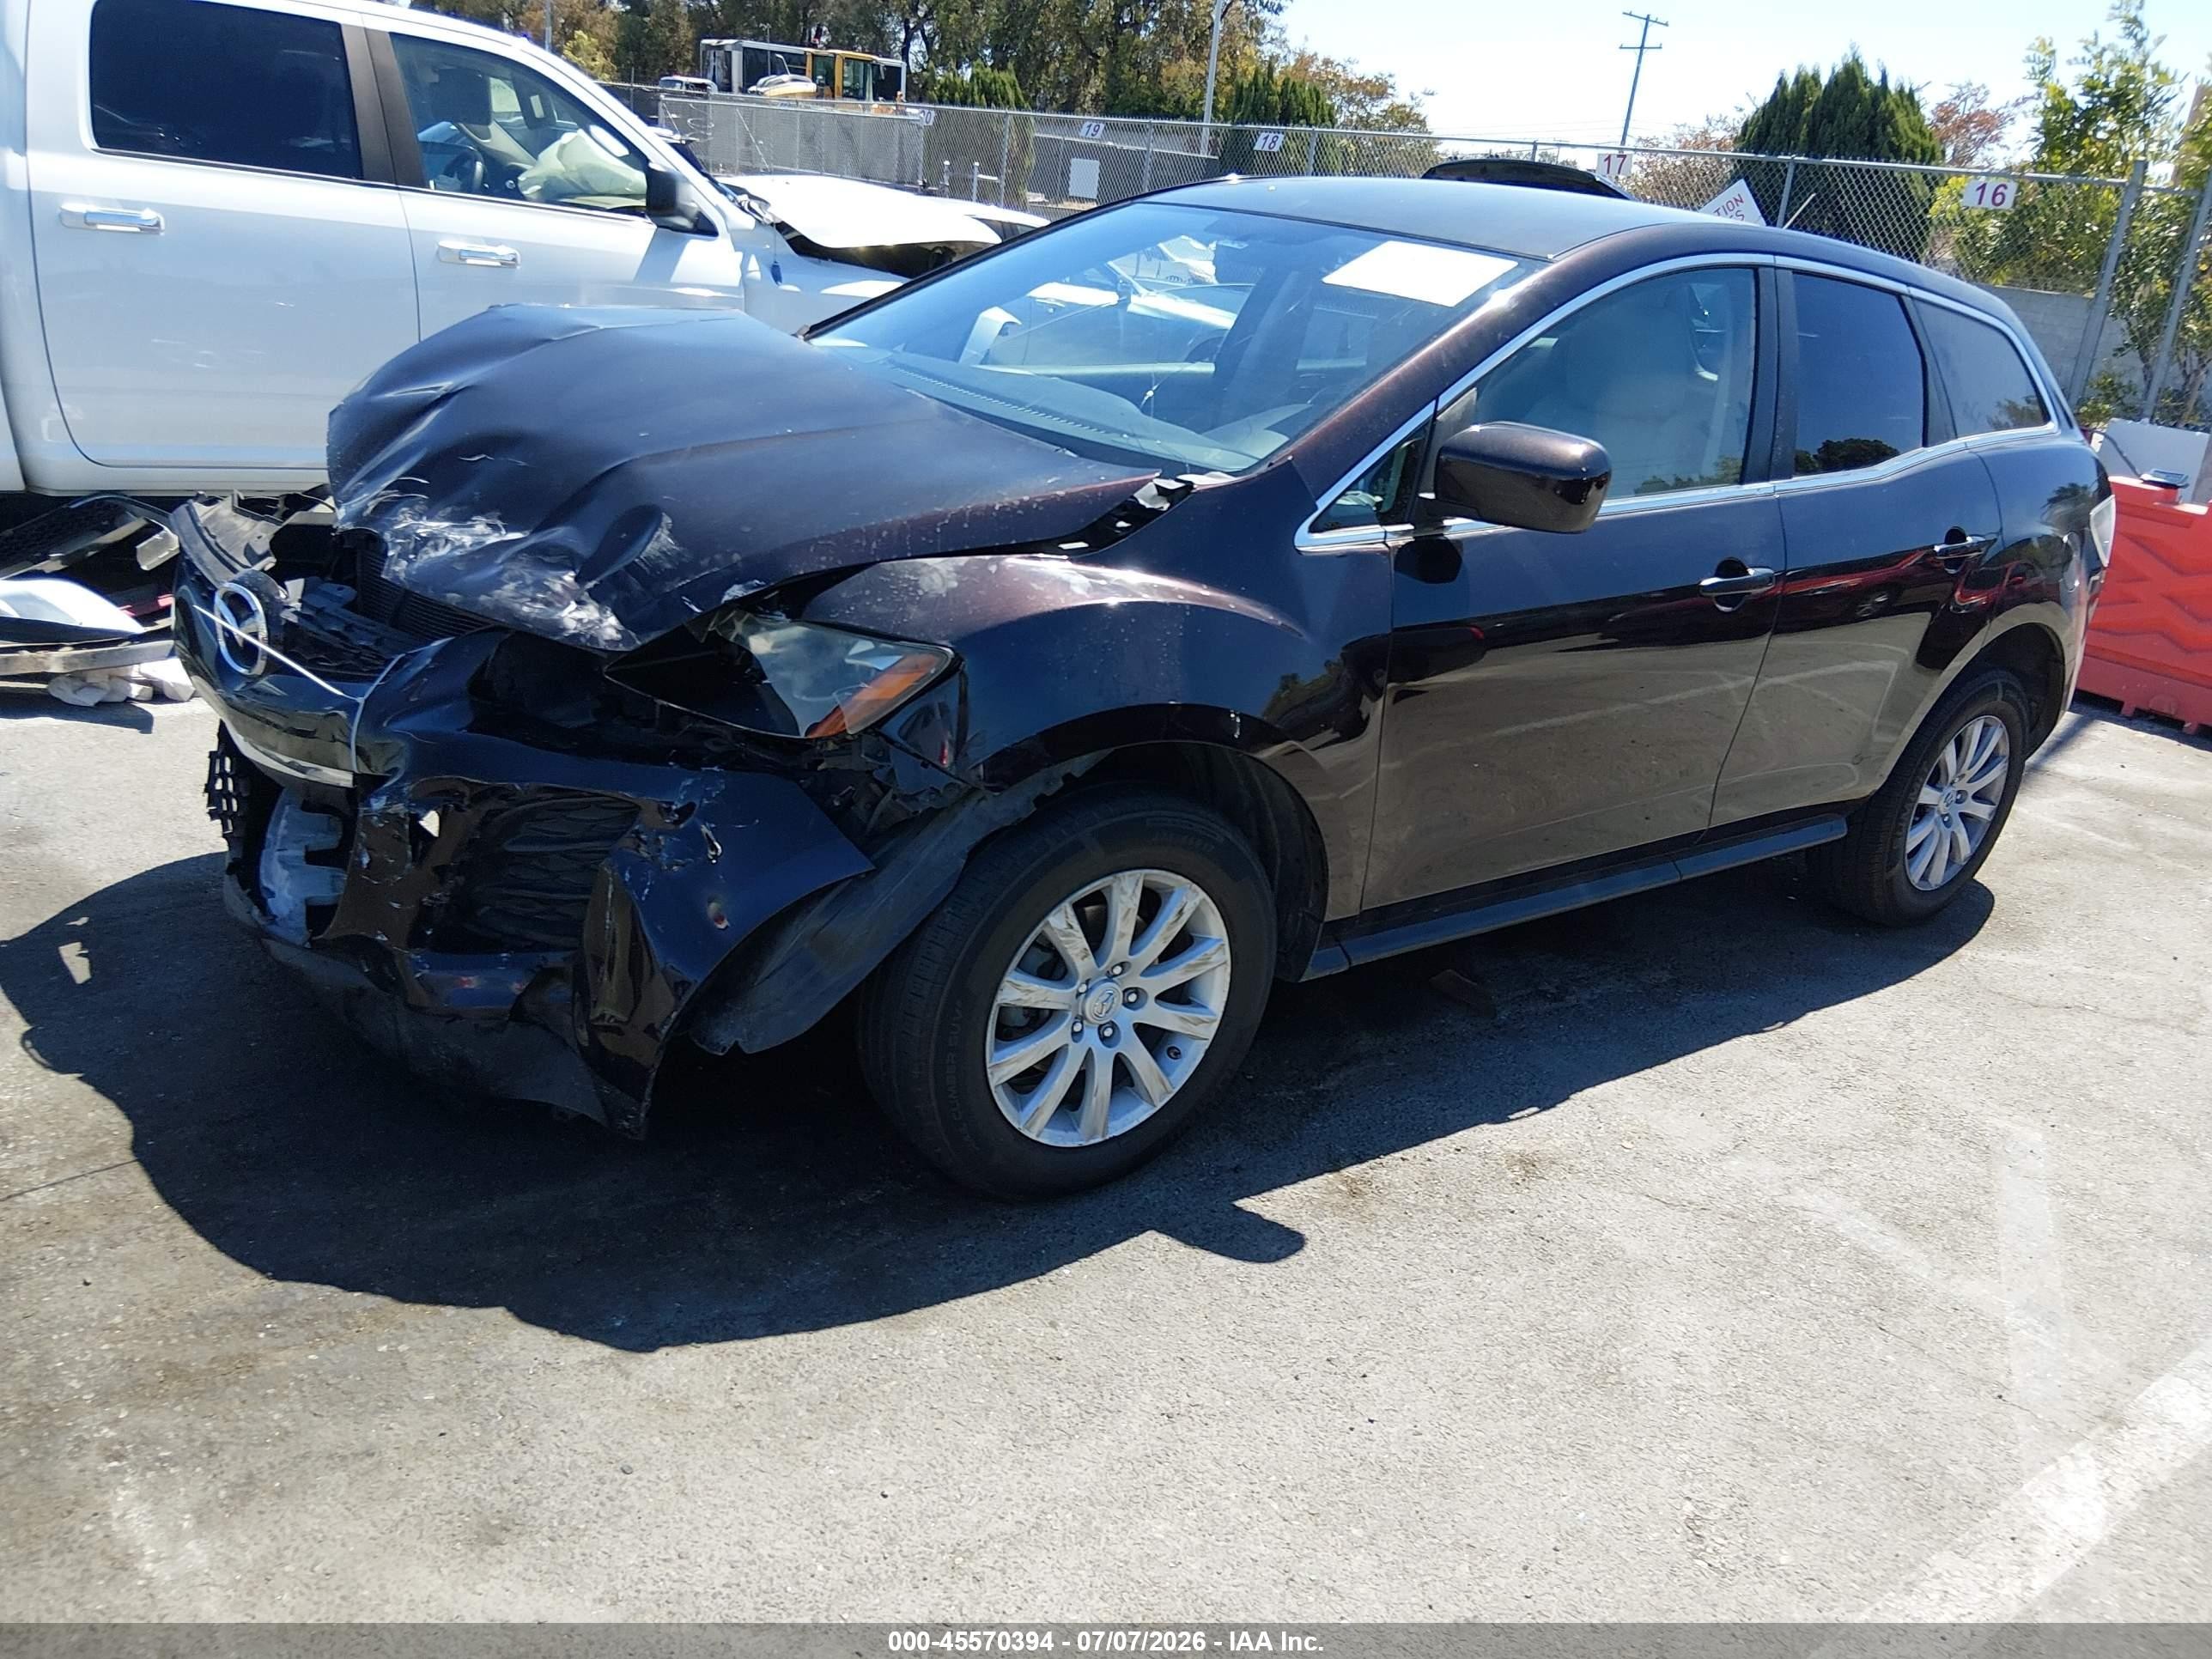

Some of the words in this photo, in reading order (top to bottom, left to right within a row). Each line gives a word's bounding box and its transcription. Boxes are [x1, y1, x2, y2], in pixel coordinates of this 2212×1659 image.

[1084, 123, 1101, 137] 19
[1261, 134, 1279, 150] 18
[1603, 154, 1627, 175] 17
[1975, 182, 2008, 207] 16
